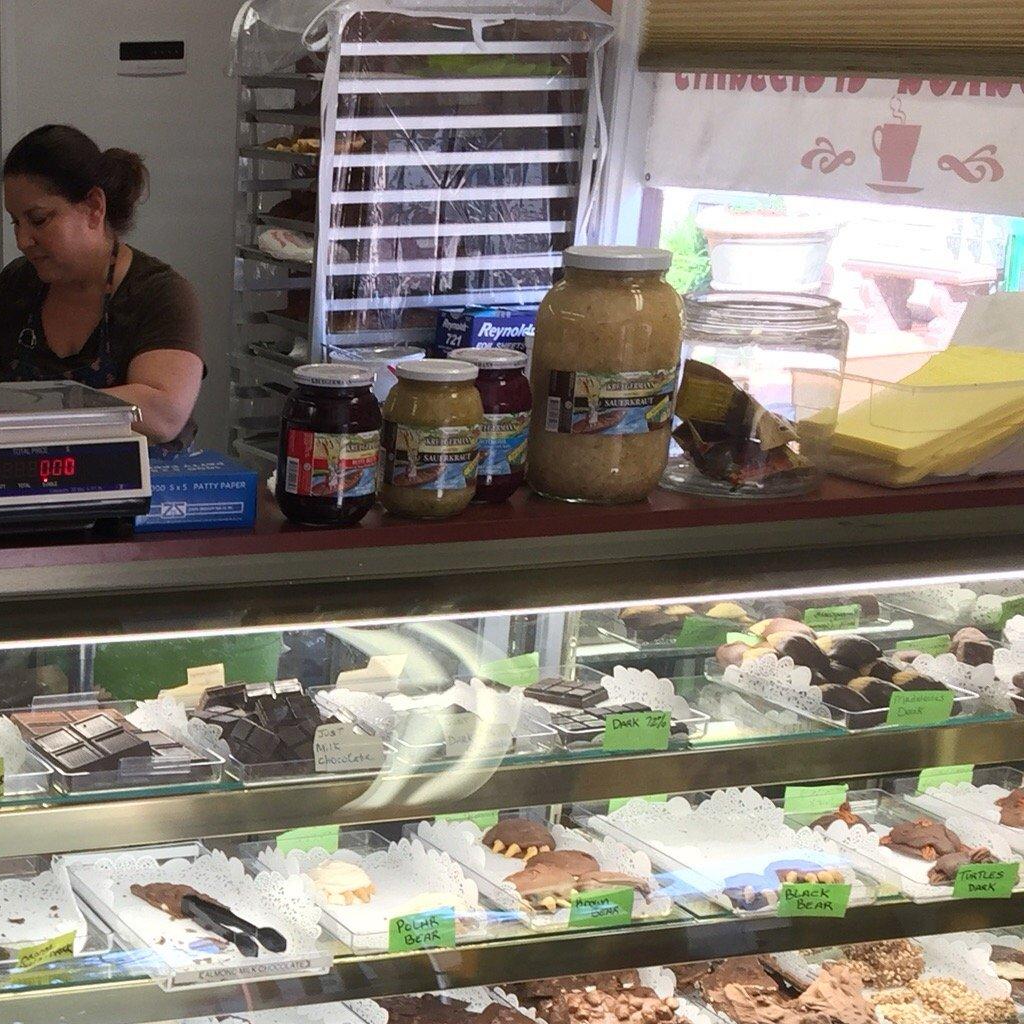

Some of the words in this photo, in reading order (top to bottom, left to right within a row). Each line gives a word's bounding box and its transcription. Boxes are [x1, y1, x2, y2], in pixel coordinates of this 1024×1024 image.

[478, 322, 535, 340] Reynolds
[445, 333, 462, 346] 721
[193, 482, 218, 491] PATTY
[220, 481, 247, 490] PAPER
[959, 869, 1005, 881] TURTLES
[785, 887, 831, 901] BLACK
[968, 883, 996, 892] DARK
[796, 898, 834, 911] BEAR
[395, 915, 440, 934] POLAR
[403, 929, 441, 945] BEAR
